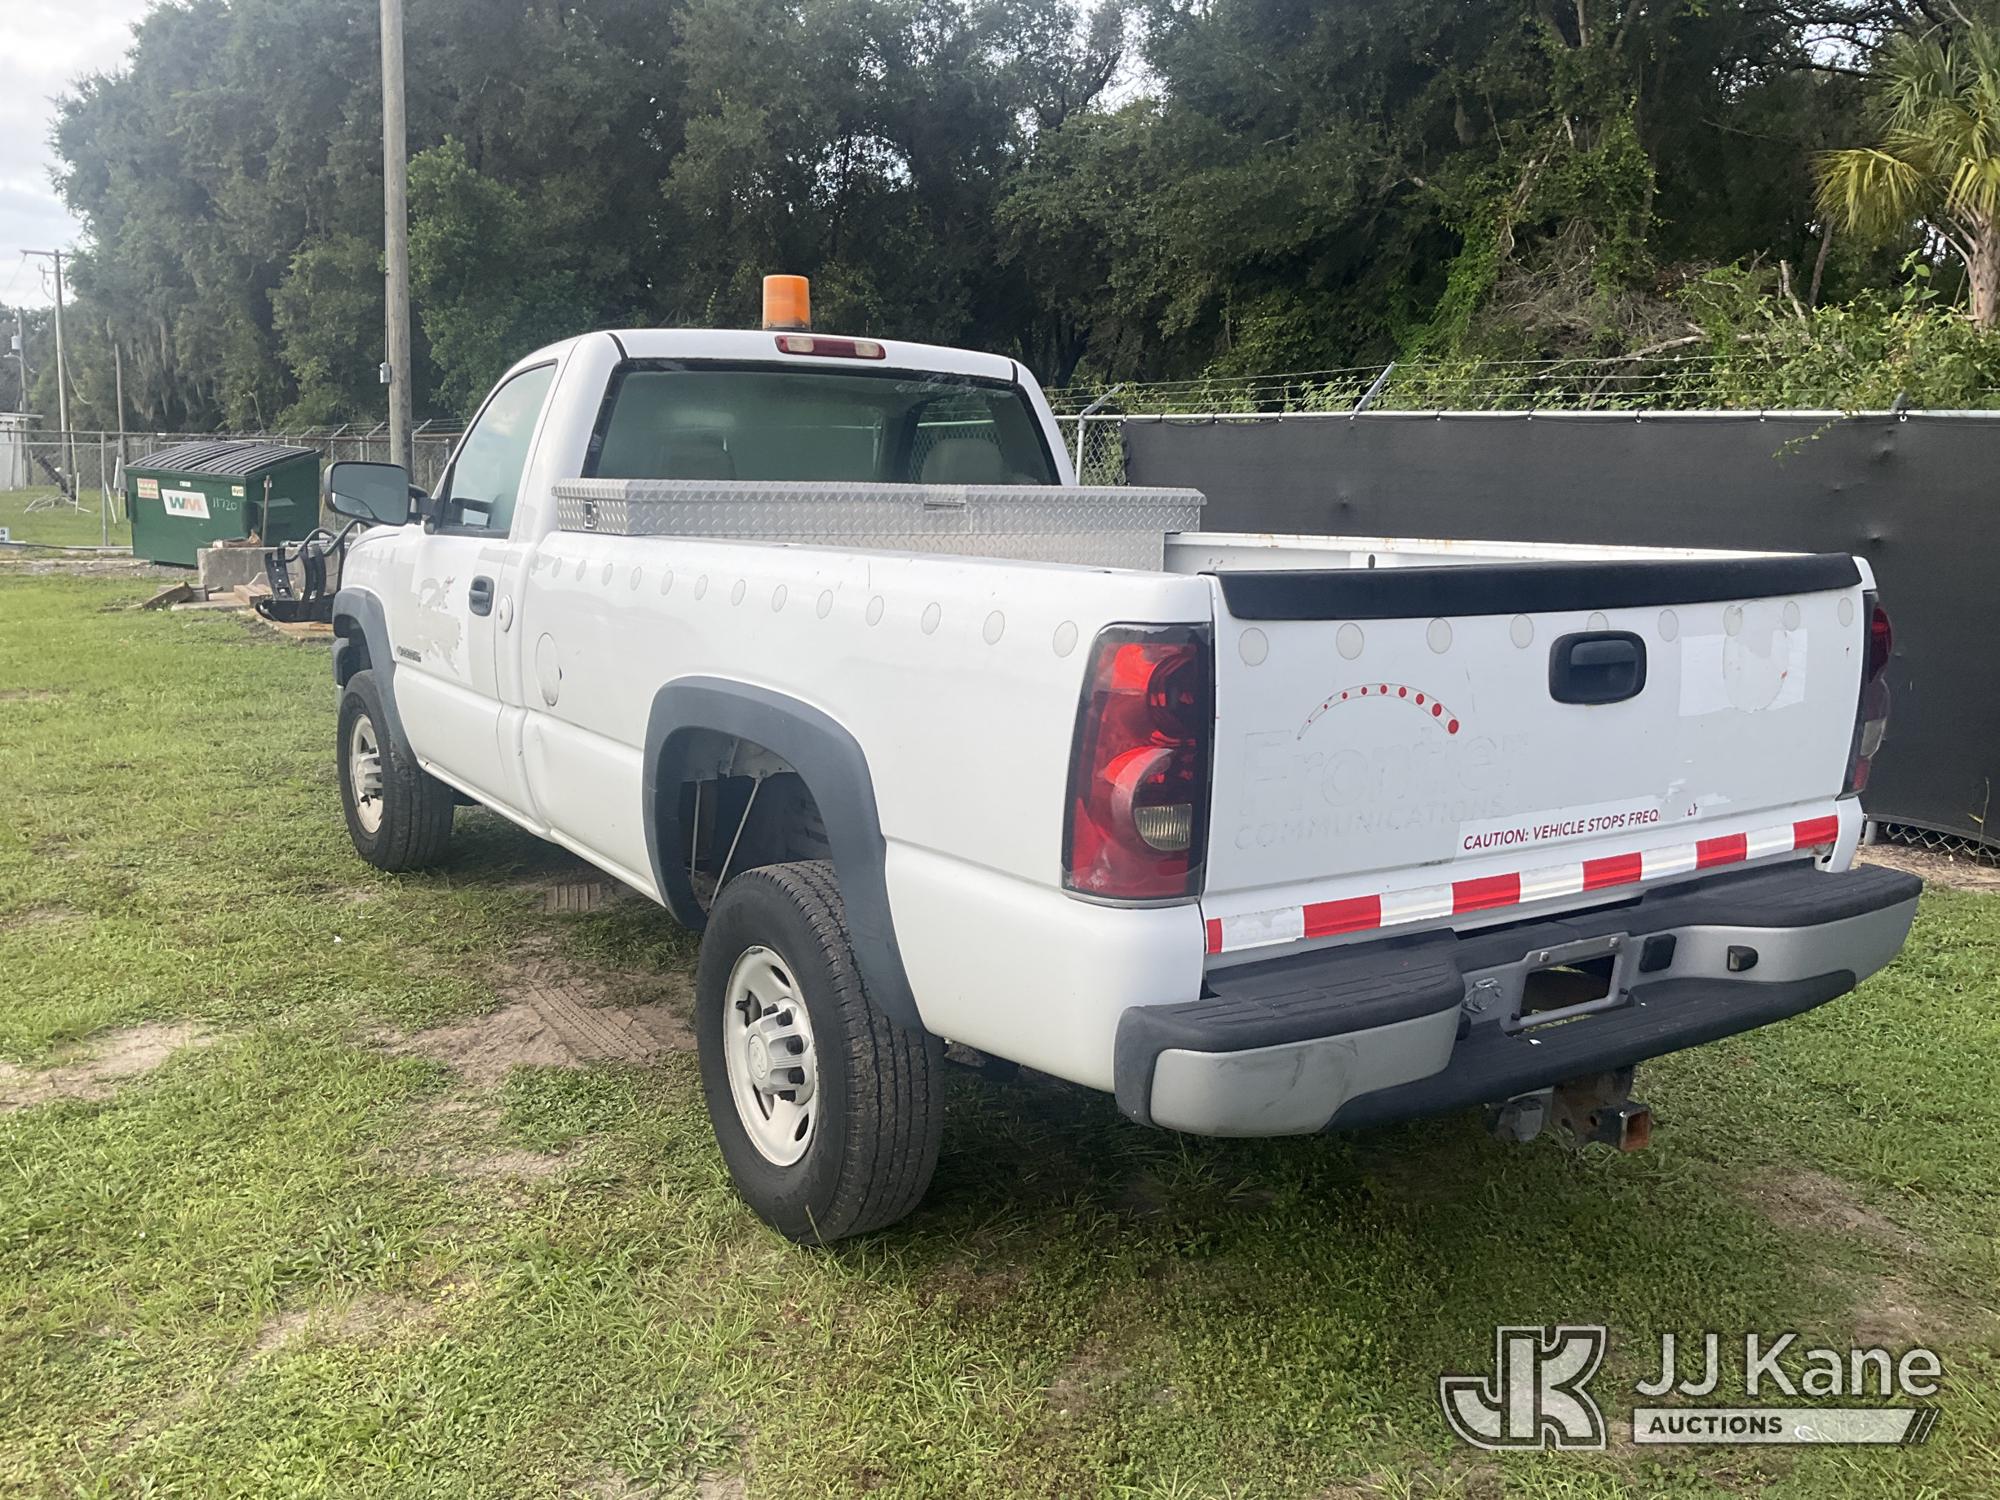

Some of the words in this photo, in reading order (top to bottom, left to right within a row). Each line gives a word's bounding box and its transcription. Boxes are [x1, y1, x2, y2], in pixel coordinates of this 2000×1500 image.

[168, 496, 203, 511] WM
[1463, 829, 1529, 851] CAUTION:
[1533, 818, 1585, 841] VEHICLE
[1587, 812, 1626, 832] STOPS
